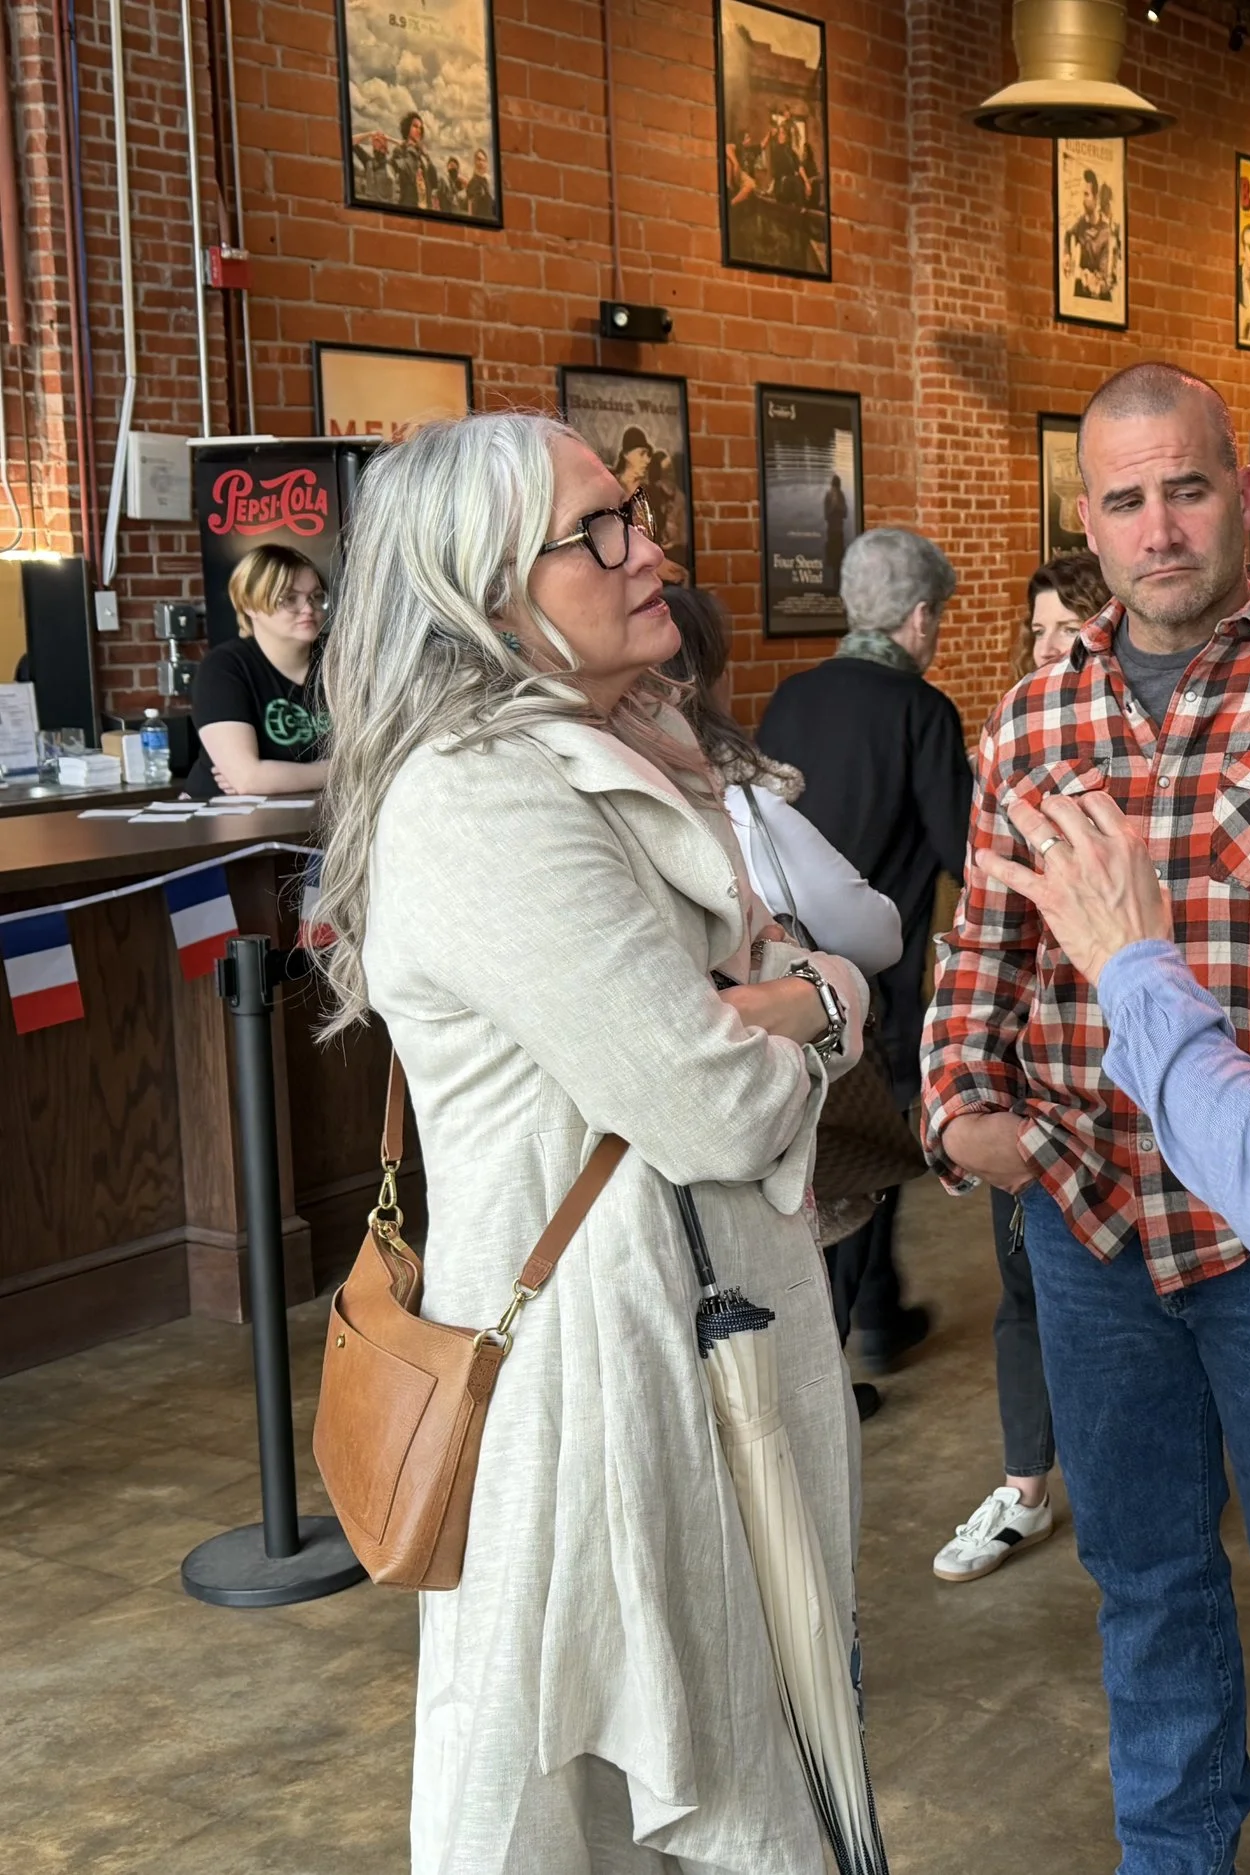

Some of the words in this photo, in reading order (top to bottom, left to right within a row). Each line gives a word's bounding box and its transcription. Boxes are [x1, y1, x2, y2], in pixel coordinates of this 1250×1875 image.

[388, 13, 407, 29] 8.9
[570, 395, 635, 416] Barking
[329, 418, 416, 442] MEK
[773, 553, 795, 568] Four
[799, 569, 823, 584] Wind
